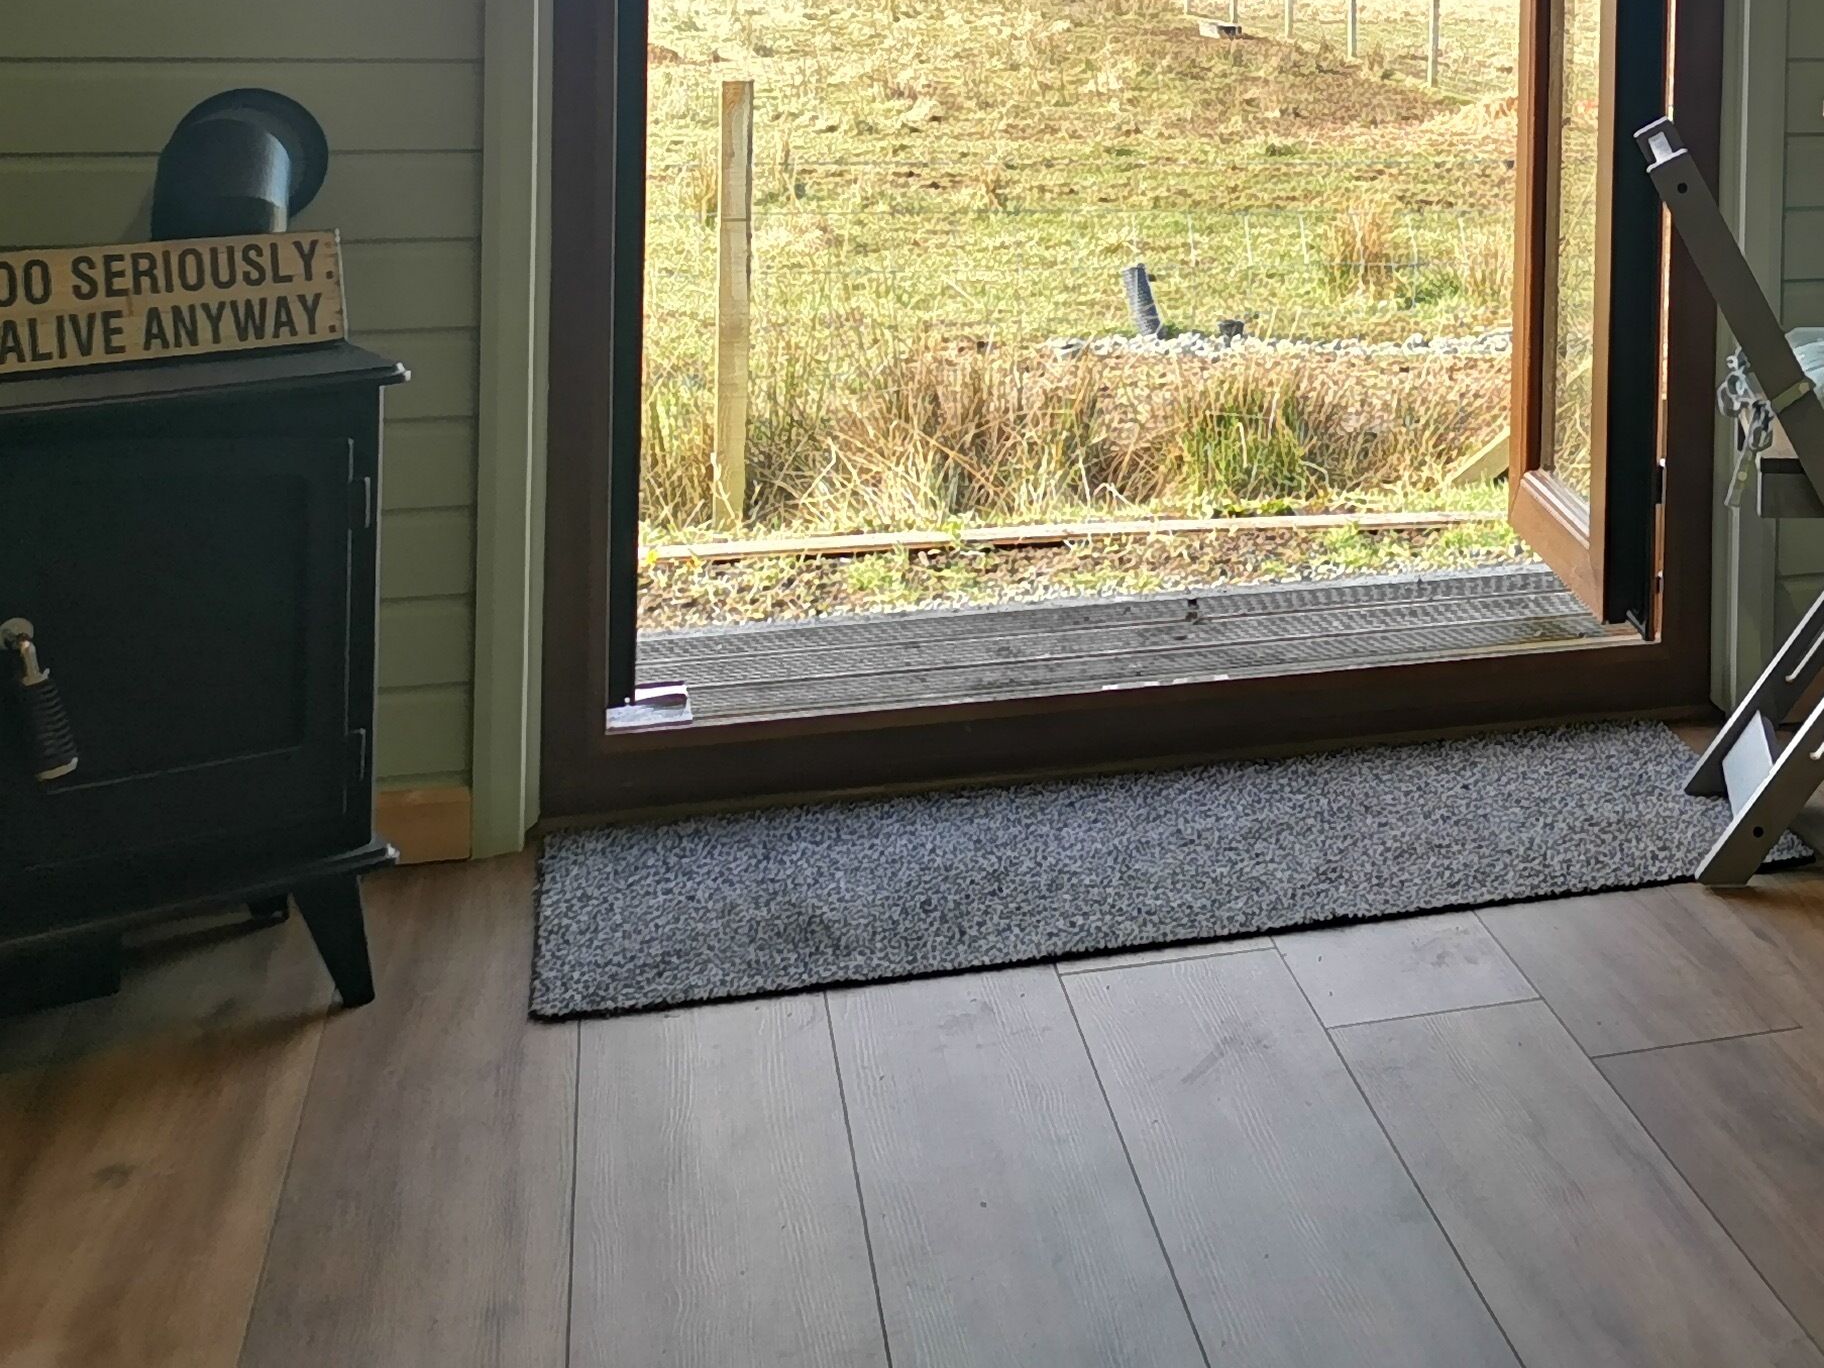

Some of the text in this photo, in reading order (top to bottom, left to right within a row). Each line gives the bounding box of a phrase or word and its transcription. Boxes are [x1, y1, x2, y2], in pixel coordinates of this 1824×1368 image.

[71, 239, 335, 301] SERIOUSLY.
[0, 293, 338, 365] ALIVE ANYWAY.
